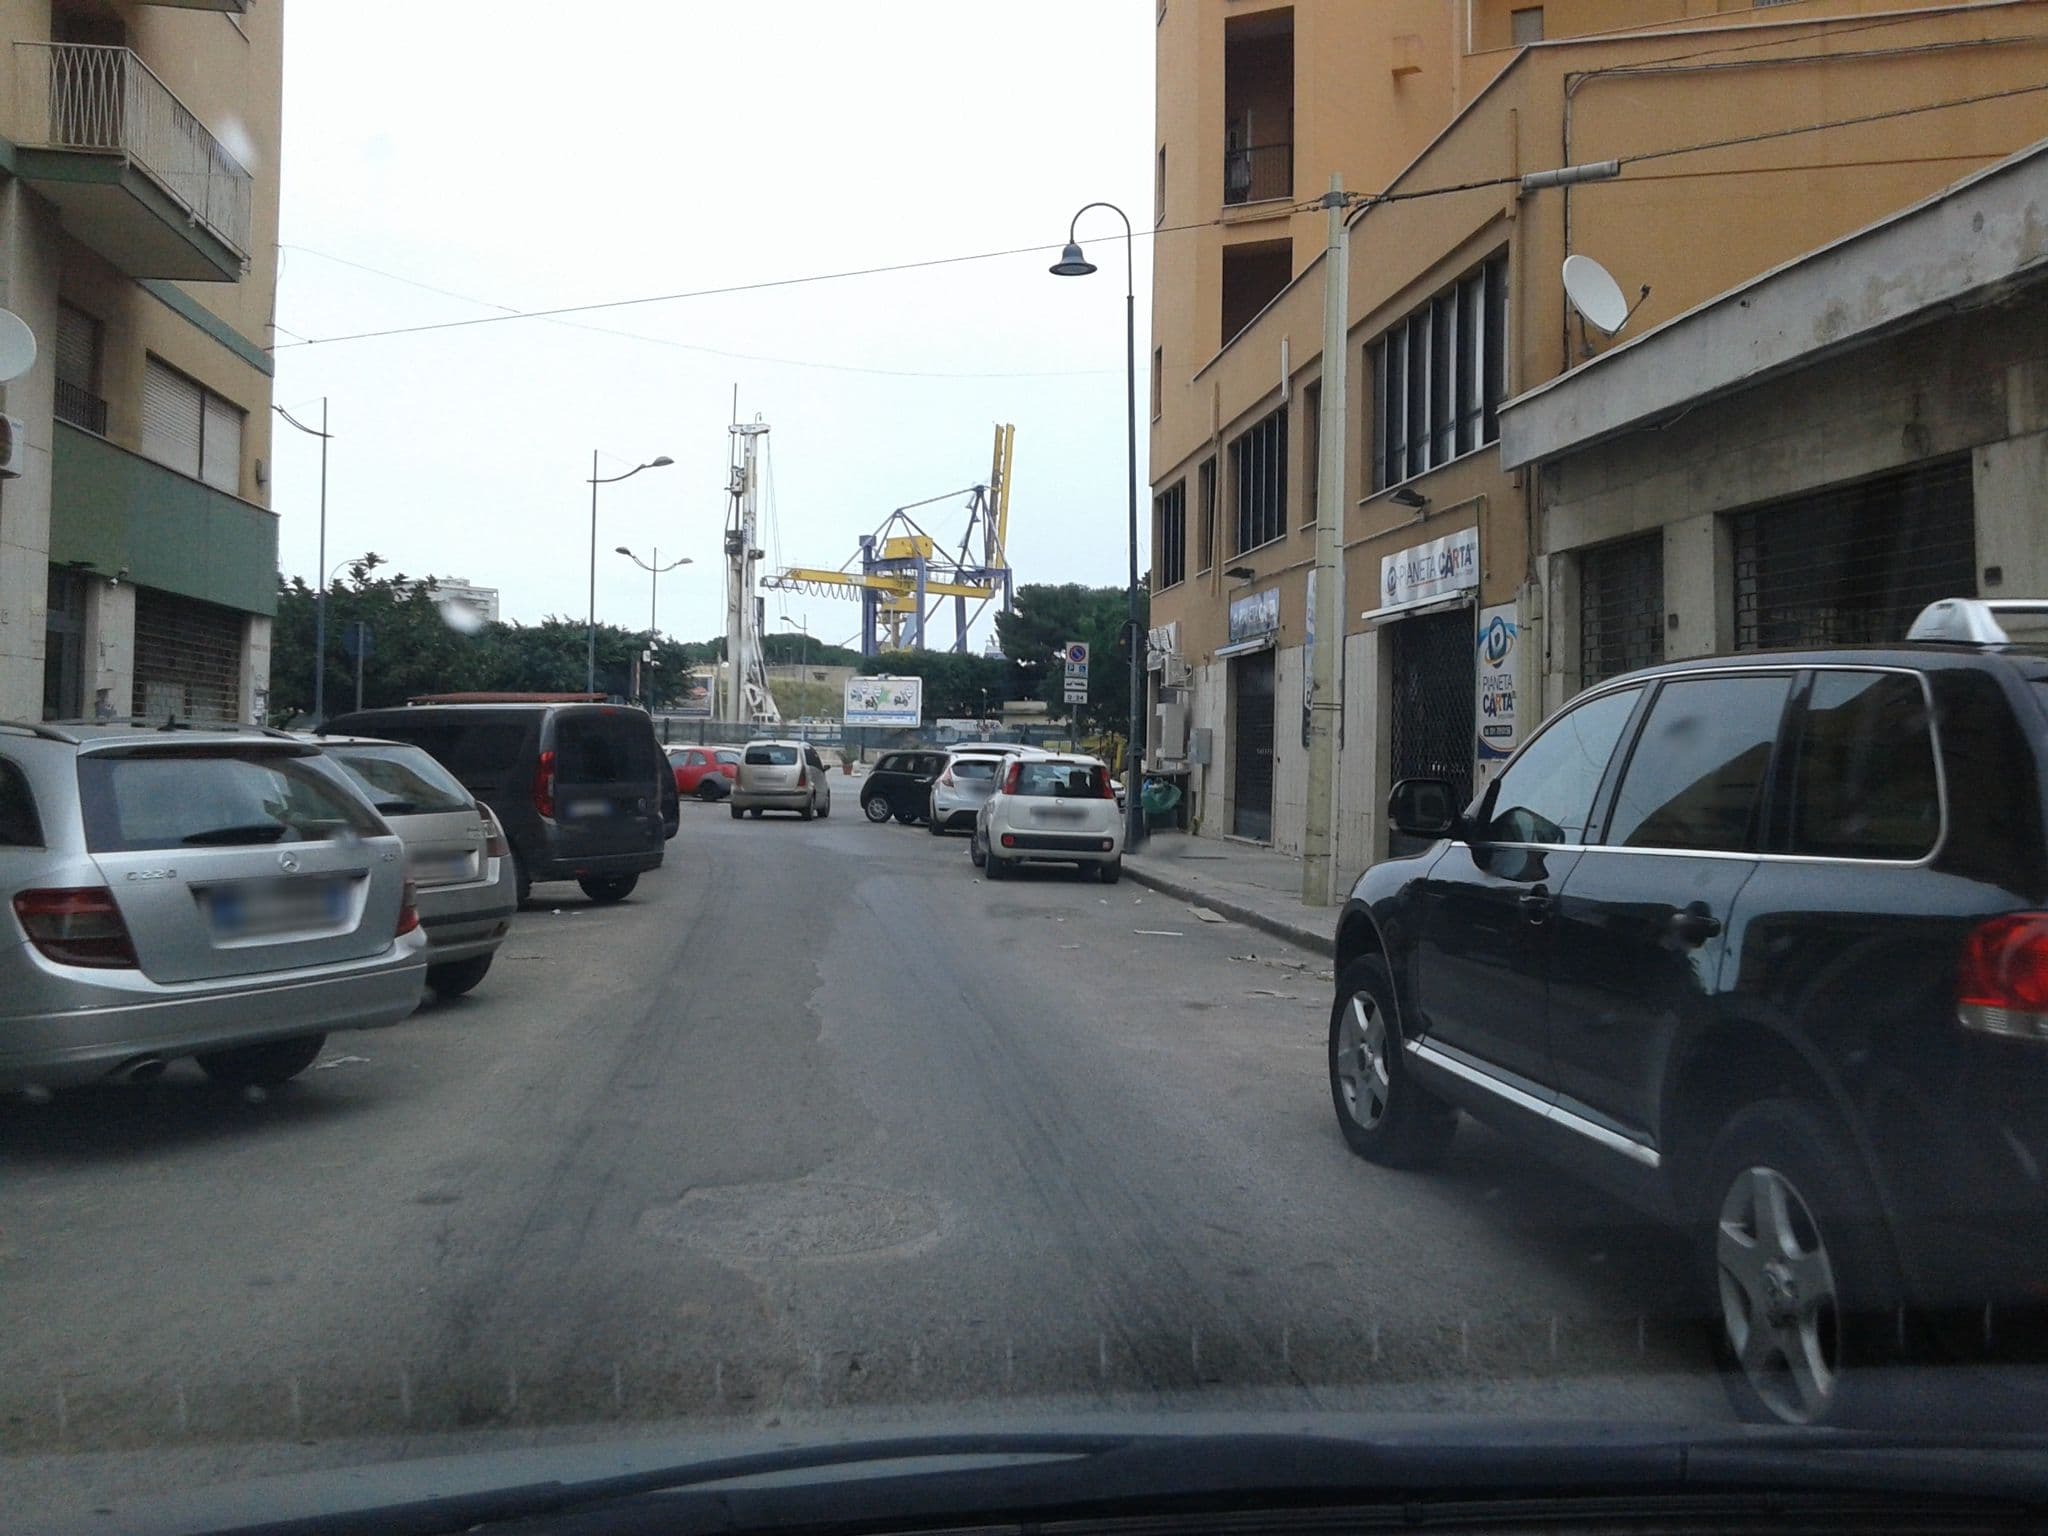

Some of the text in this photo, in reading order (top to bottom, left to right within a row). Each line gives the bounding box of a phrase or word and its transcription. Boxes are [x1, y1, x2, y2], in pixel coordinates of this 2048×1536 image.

[1398, 543, 1472, 584] PIANETA CARTA
[1483, 673, 1513, 693] PIANETA
[1483, 692, 1514, 718] CARTA
